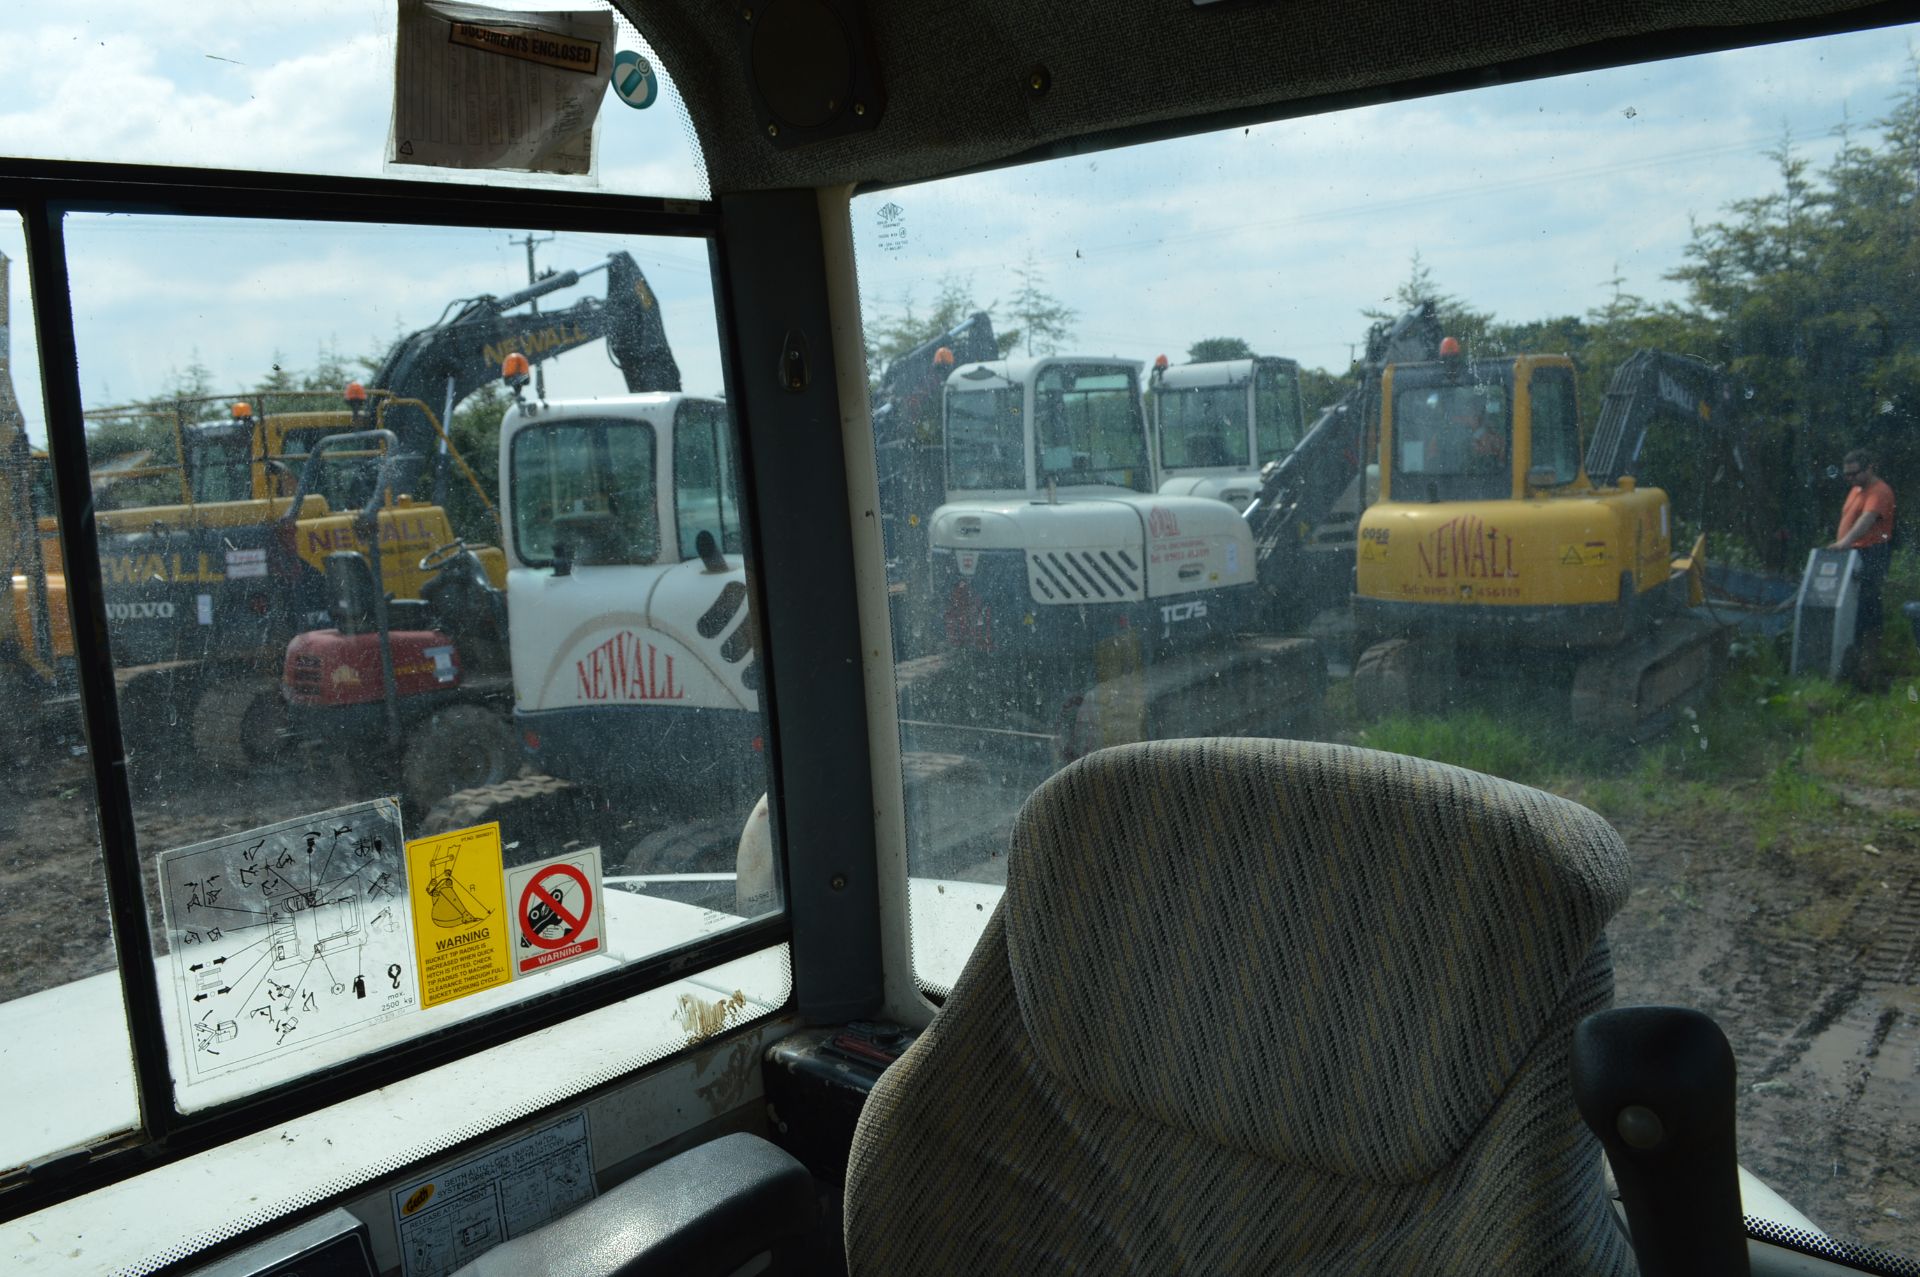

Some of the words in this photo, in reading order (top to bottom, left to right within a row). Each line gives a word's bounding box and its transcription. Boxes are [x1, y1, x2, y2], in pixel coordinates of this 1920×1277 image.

[460, 25, 529, 52] DOCUMENTS
[531, 39, 592, 64] ENCLOSED
[308, 518, 433, 553] NEALL
[1417, 514, 1520, 578] NEWALL
[105, 602, 175, 619] VOLVO
[1160, 600, 1208, 623] TC75
[576, 631, 684, 699] NEWALL
[435, 927, 490, 950] WARNING
[425, 954, 448, 965] BUCKET
[459, 945, 480, 955] RADIUS
[426, 959, 458, 972] INCREASED
[460, 954, 476, 962] WHEN
[477, 948, 495, 957] QUICK
[537, 945, 582, 964] WARNING
[427, 970, 443, 979] HITCH
[473, 956, 492, 965] CHECK
[438, 972, 459, 982] RADIUS
[468, 963, 493, 974] MACHINE
[428, 980, 462, 994] CLEARANCE
[464, 971, 490, 982] THROUGH
[429, 989, 452, 1001] BUCKET
[453, 981, 479, 993] WORKING
[382, 1000, 399, 1011] 2500
[409, 1211, 441, 1229] RELEASE
